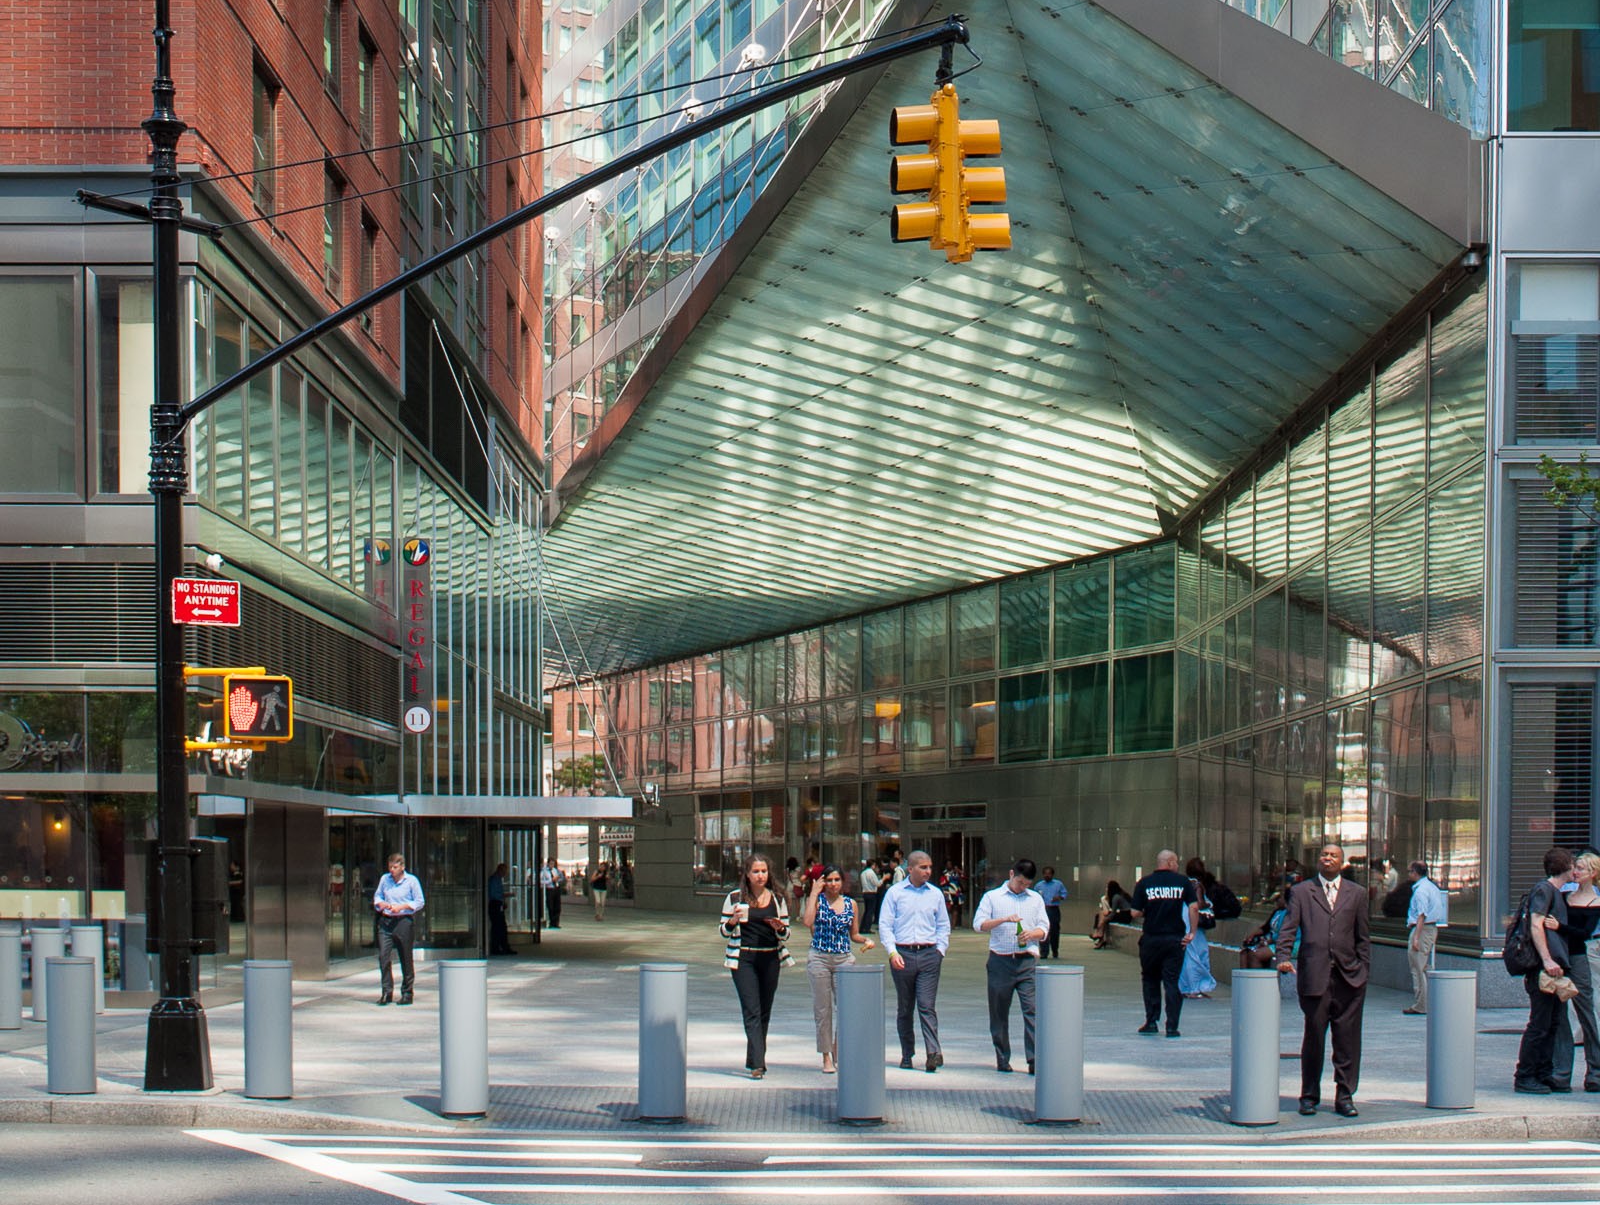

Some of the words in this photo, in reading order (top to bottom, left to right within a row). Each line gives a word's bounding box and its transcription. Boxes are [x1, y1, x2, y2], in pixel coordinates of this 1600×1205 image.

[177, 582, 190, 593] NO
[193, 583, 236, 595] STANDING
[184, 595, 230, 607] ANYTIME
[408, 579, 426, 694] REGAL
[410, 713, 426, 726] 11
[1145, 886, 1184, 901] SECURITY
